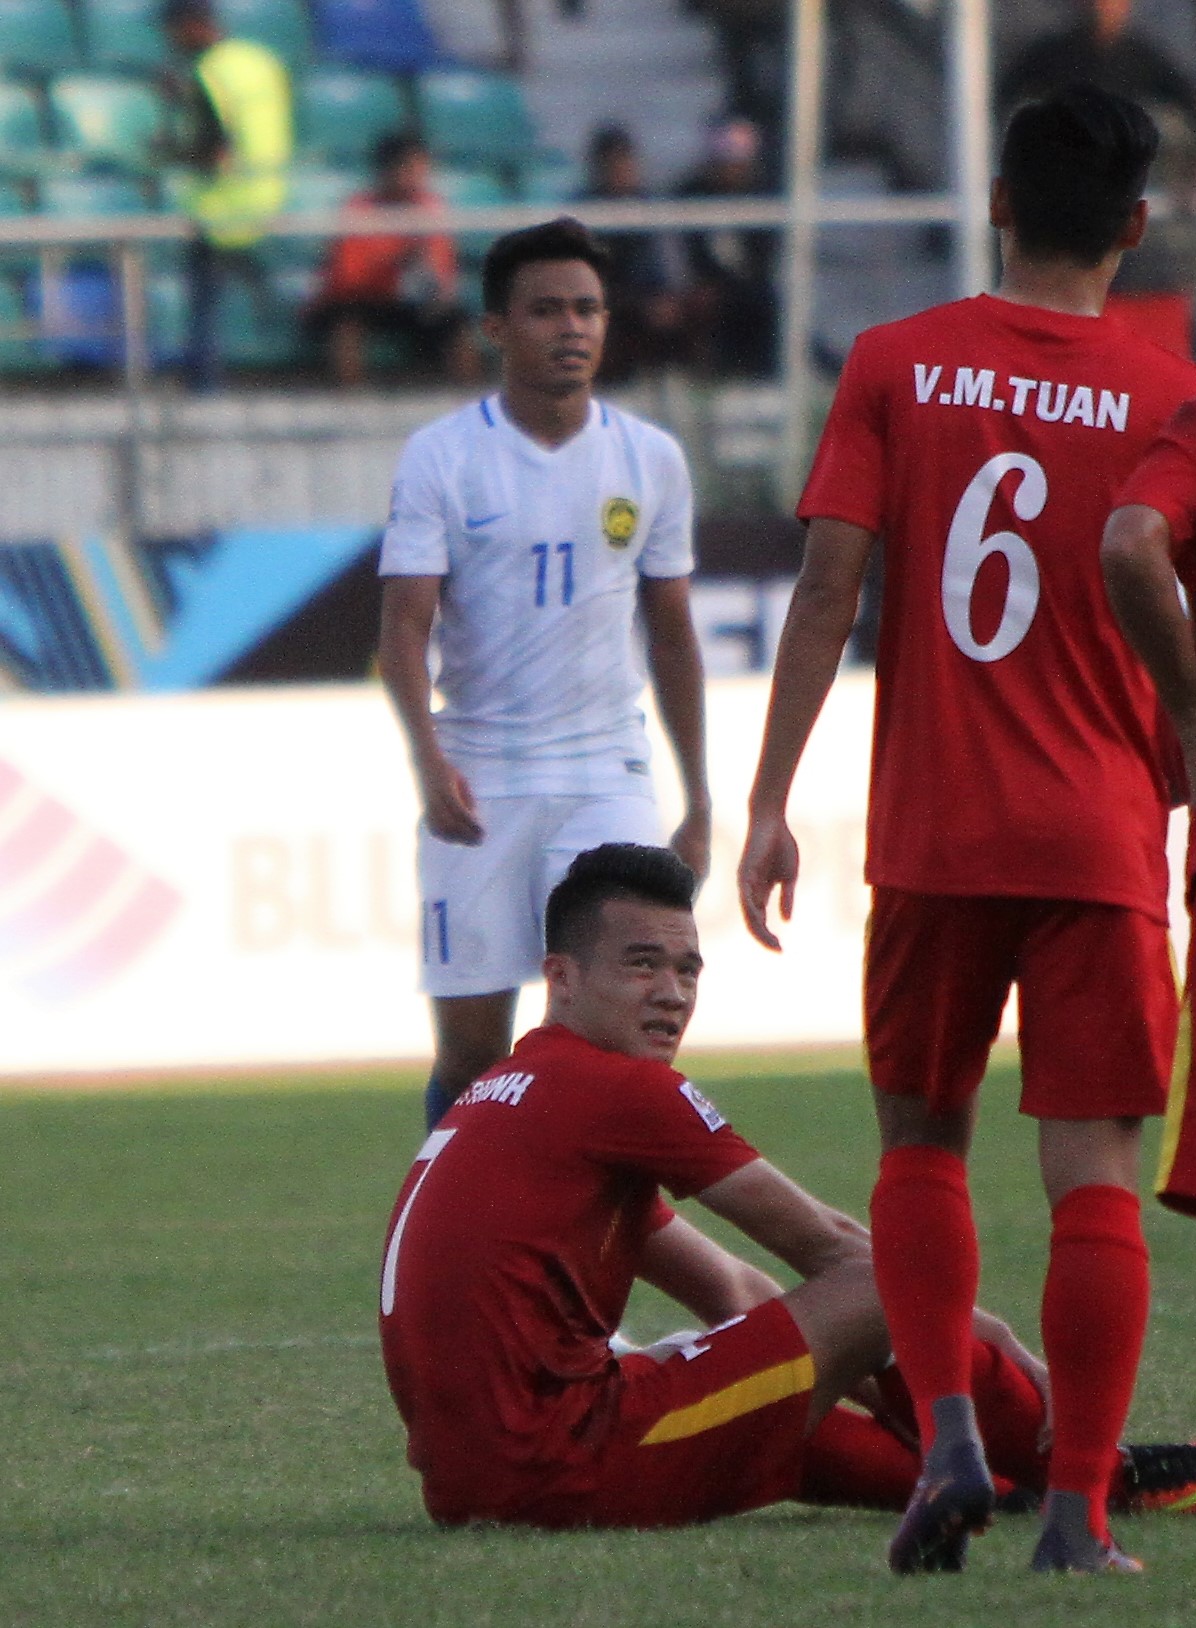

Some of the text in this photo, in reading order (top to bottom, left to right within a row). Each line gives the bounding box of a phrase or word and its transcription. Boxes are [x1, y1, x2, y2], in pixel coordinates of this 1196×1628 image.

[913, 363, 1130, 433] V.M.TUAN
[531, 541, 576, 608] 11
[941, 452, 1048, 662] 6
[380, 1129, 458, 1316] 7
